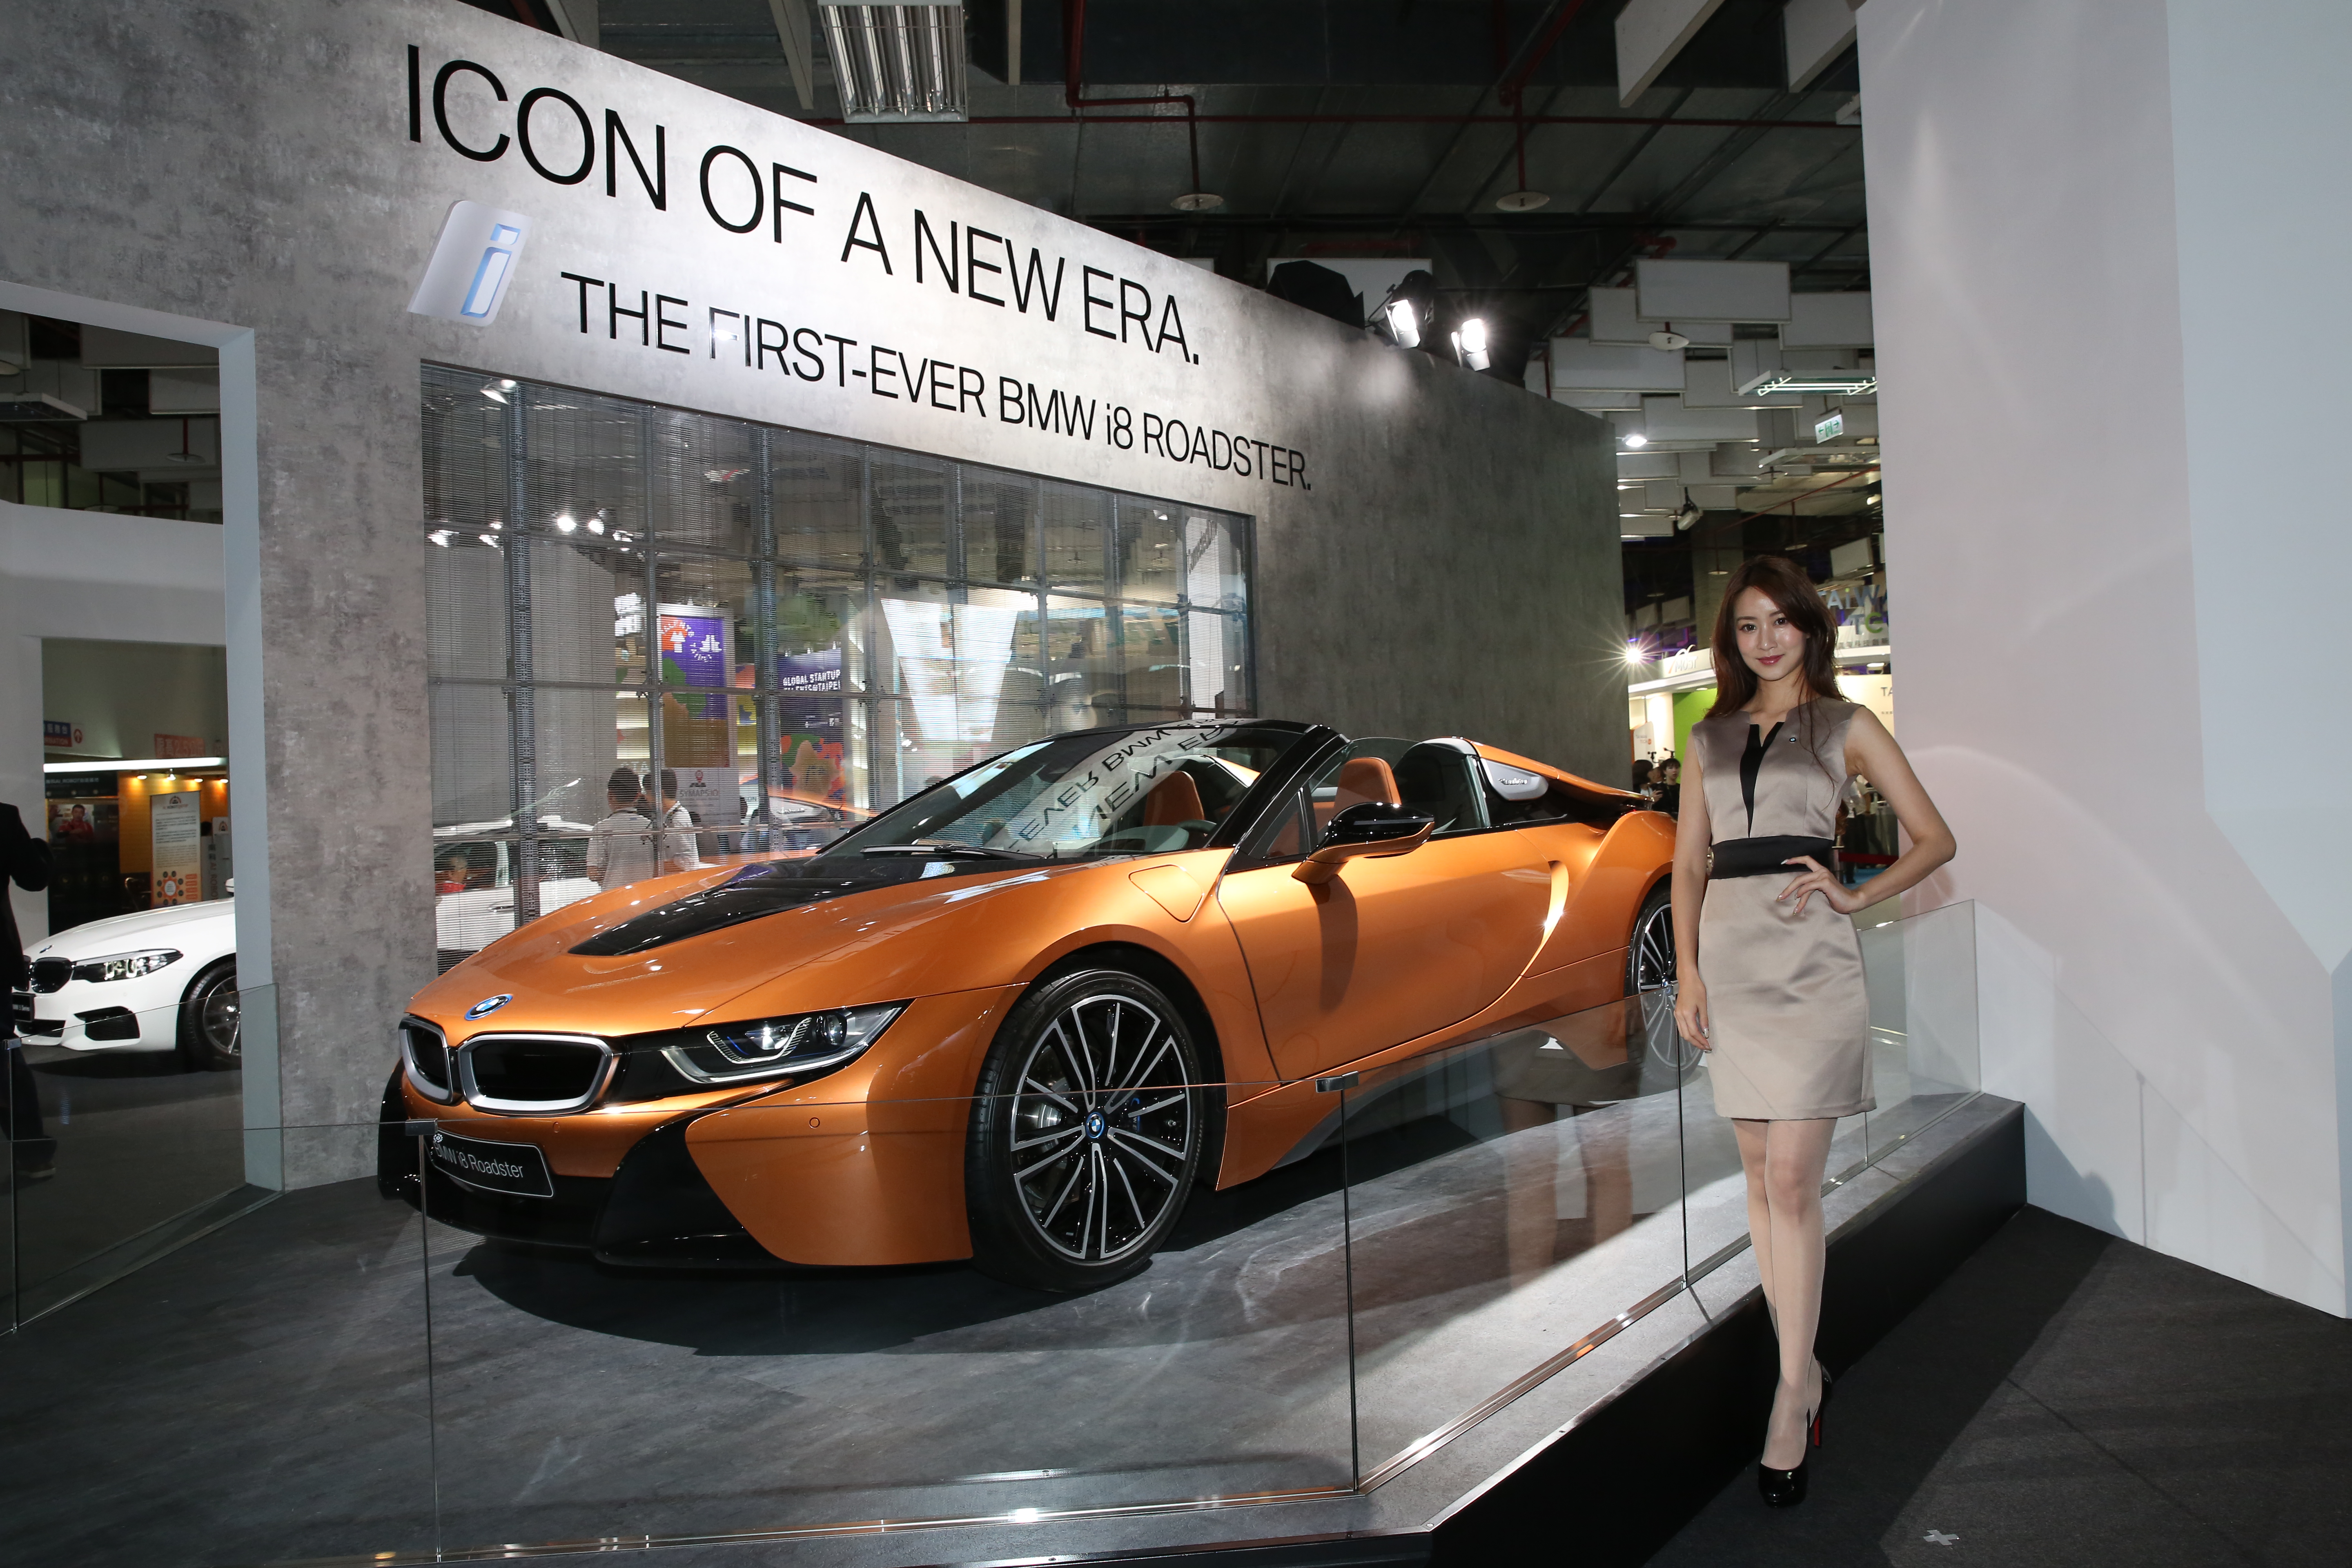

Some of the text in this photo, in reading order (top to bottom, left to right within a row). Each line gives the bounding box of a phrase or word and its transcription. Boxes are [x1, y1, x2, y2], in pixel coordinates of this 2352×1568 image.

[408, 44, 1199, 365] ICON OF A NEW ERA.
[561, 272, 1312, 491] THE FIRST-EVER BMW i8 ROADSTER.
[783, 669, 841, 686] GLOBAL STARTUP
[433, 1141, 523, 1178] BMW i8 Roadster
